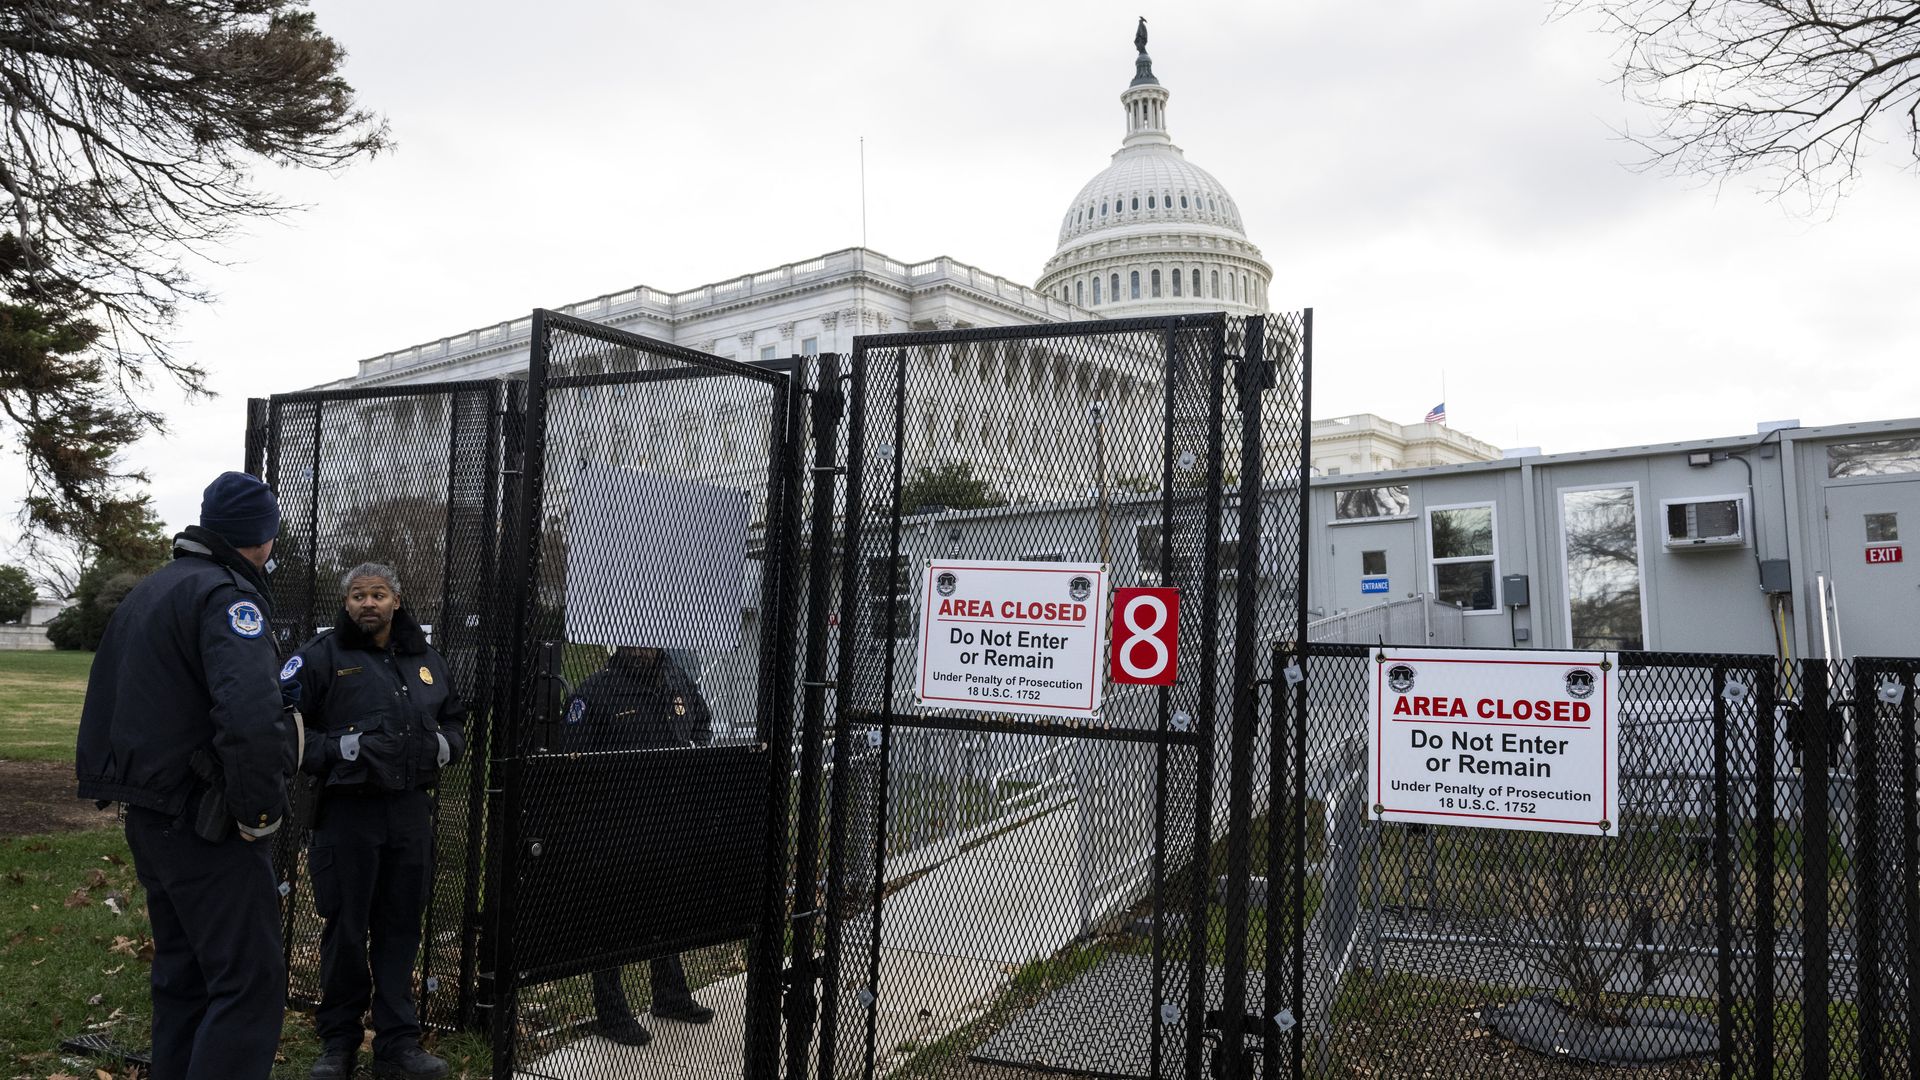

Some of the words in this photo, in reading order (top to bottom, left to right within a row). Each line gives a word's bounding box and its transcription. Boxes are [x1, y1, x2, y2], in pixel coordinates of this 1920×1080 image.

[1870, 548, 1897, 562] EXIT
[1362, 582, 1388, 591] ENTRANCE
[939, 599, 994, 617] AREA
[1001, 601, 1086, 621] CLOSED
[950, 628, 974, 644] Do
[981, 629, 1012, 647] Not
[1018, 631, 1068, 649] Enter
[1120, 596, 1168, 678] 8
[960, 652, 979, 664] or
[985, 649, 1053, 669] Remain
[933, 672, 962, 681] Under
[966, 674, 1002, 686] Penalty
[1006, 676, 1016, 685] of
[1019, 677, 1082, 689] Prosecution
[968, 687, 978, 696] 18
[982, 687, 1012, 698] U.S.C.
[1017, 690, 1040, 700] 1752
[1393, 696, 1468, 717] AREA
[1477, 699, 1591, 722] CLOSED
[1412, 730, 1443, 749] Do
[1452, 731, 1493, 751] Not
[1502, 733, 1568, 755] Enter
[1426, 758, 1451, 772] or
[1459, 754, 1550, 777] Remain
[1392, 780, 1431, 792] Under
[1435, 783, 1484, 797] Penalty
[1489, 786, 1502, 796] of
[1507, 787, 1591, 801] Prosecution
[1439, 798, 1453, 808] 18
[1459, 799, 1499, 811] U.S.C.
[1505, 802, 1535, 813] 1752
